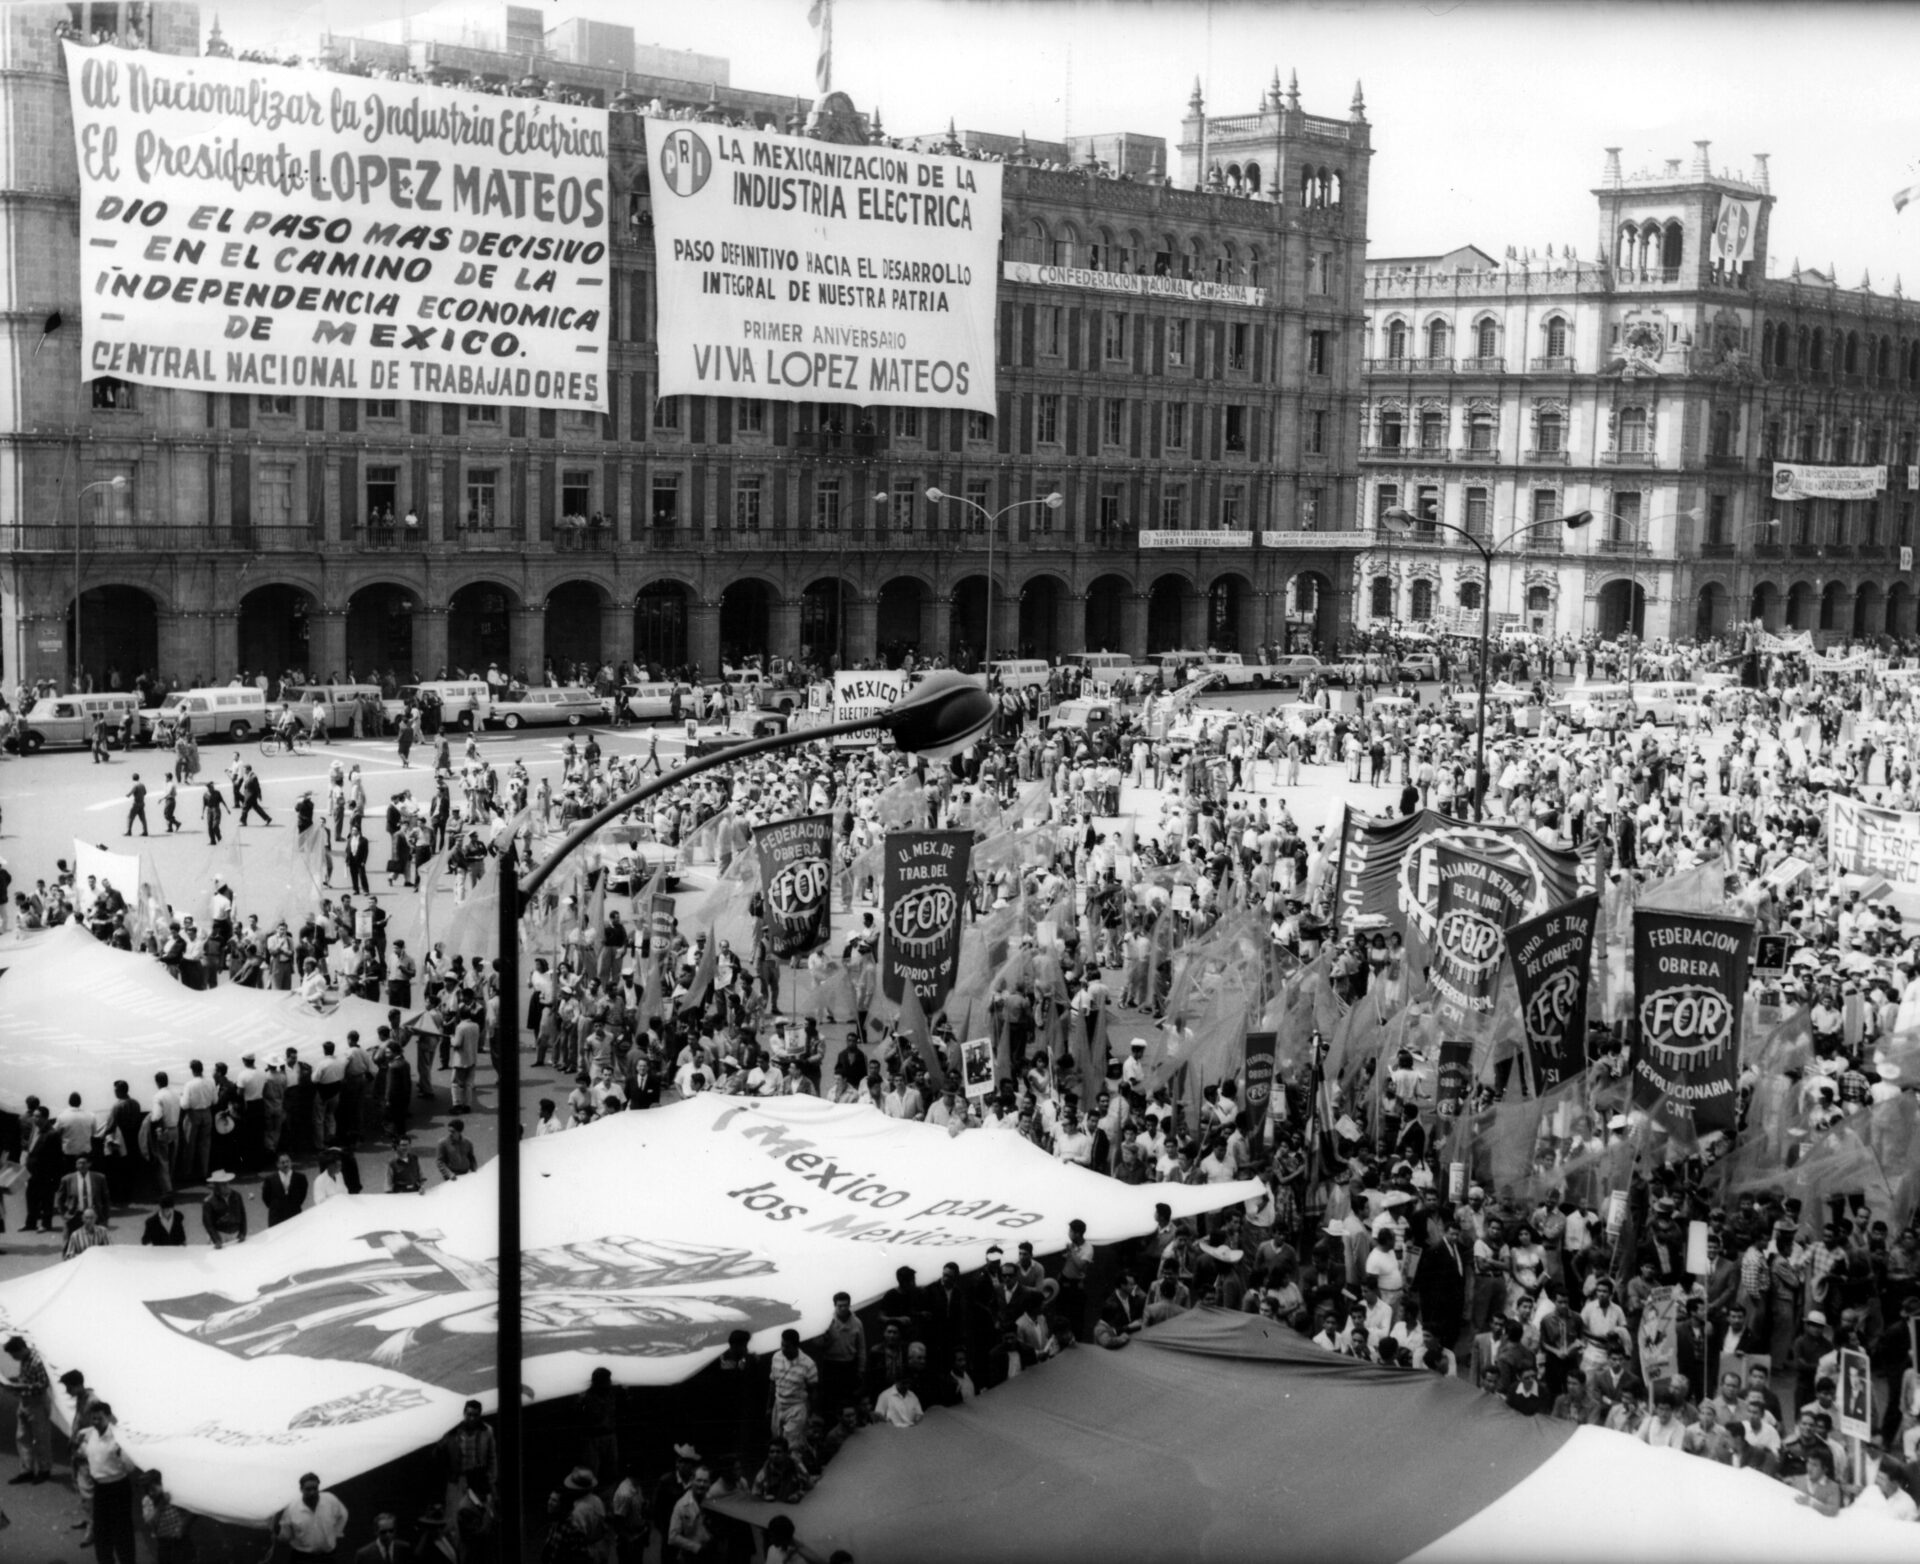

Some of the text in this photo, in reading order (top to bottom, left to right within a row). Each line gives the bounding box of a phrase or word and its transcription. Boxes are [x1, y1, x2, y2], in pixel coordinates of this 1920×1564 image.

[81, 58, 119, 109] Al
[129, 61, 325, 131] Nacionalizar
[331, 88, 361, 134] la
[365, 93, 494, 147] Industria
[82, 123, 604, 228] El Presidente LOPEZ MATEOS
[719, 135, 977, 193] LA MEXICANIZACION DE LA
[733, 171, 972, 231] INDUSTRIA ELECTRICA
[96, 198, 605, 264] DIO EL PASO MAS DECISIVO
[144, 235, 556, 292] EN EL CAMINO DE LA
[674, 239, 971, 286] PASO DEFINITIVO HACIA EL DESARROLLO
[95, 268, 600, 331] INDEPENDENCIA ECONOMICA
[702, 271, 949, 312] INTEGRAL DE NUESTRA PATRIA
[1038, 265, 1138, 291] CONFEDERACION
[1141, 276, 1188, 296] NACIONAL
[1191, 281, 1247, 302] CAMPESINA
[224, 316, 528, 357] DE MEXICO.
[743, 320, 906, 350] PRIMER ANIVERSARIO
[91, 341, 600, 401] CENTRAL NACIONAL DE TRABAJADORES
[693, 343, 970, 396] VIVA LOPEZ MATEOS
[841, 680, 898, 704] MEXICO
[839, 728, 894, 740] ROGRES
[760, 823, 832, 854] FEDERACION
[773, 841, 821, 861] OBRERA
[899, 842, 955, 863] U. MEX. DE
[780, 862, 828, 912] FOR
[899, 864, 948, 881] TRAB. DEL
[1440, 861, 1487, 881] ALIANZA
[902, 892, 950, 934] FOR
[1453, 882, 1466, 898] DE
[1466, 887, 1479, 905] LA
[1446, 916, 1496, 959] FOR
[1518, 934, 1544, 966] SIND.
[1546, 917, 1561, 937] DE
[1648, 927, 1739, 955] FEDERACION
[929, 967, 937, 980] Y
[1659, 956, 1720, 978] OBRERA
[914, 983, 938, 998] CNT
[1653, 997, 1723, 1038] FOR
[1636, 1058, 1734, 1100] REVOLUCIONARIA
[1665, 1100, 1696, 1120] CNT
[727, 1182, 808, 1222] los
[906, 1199, 1044, 1229] para
